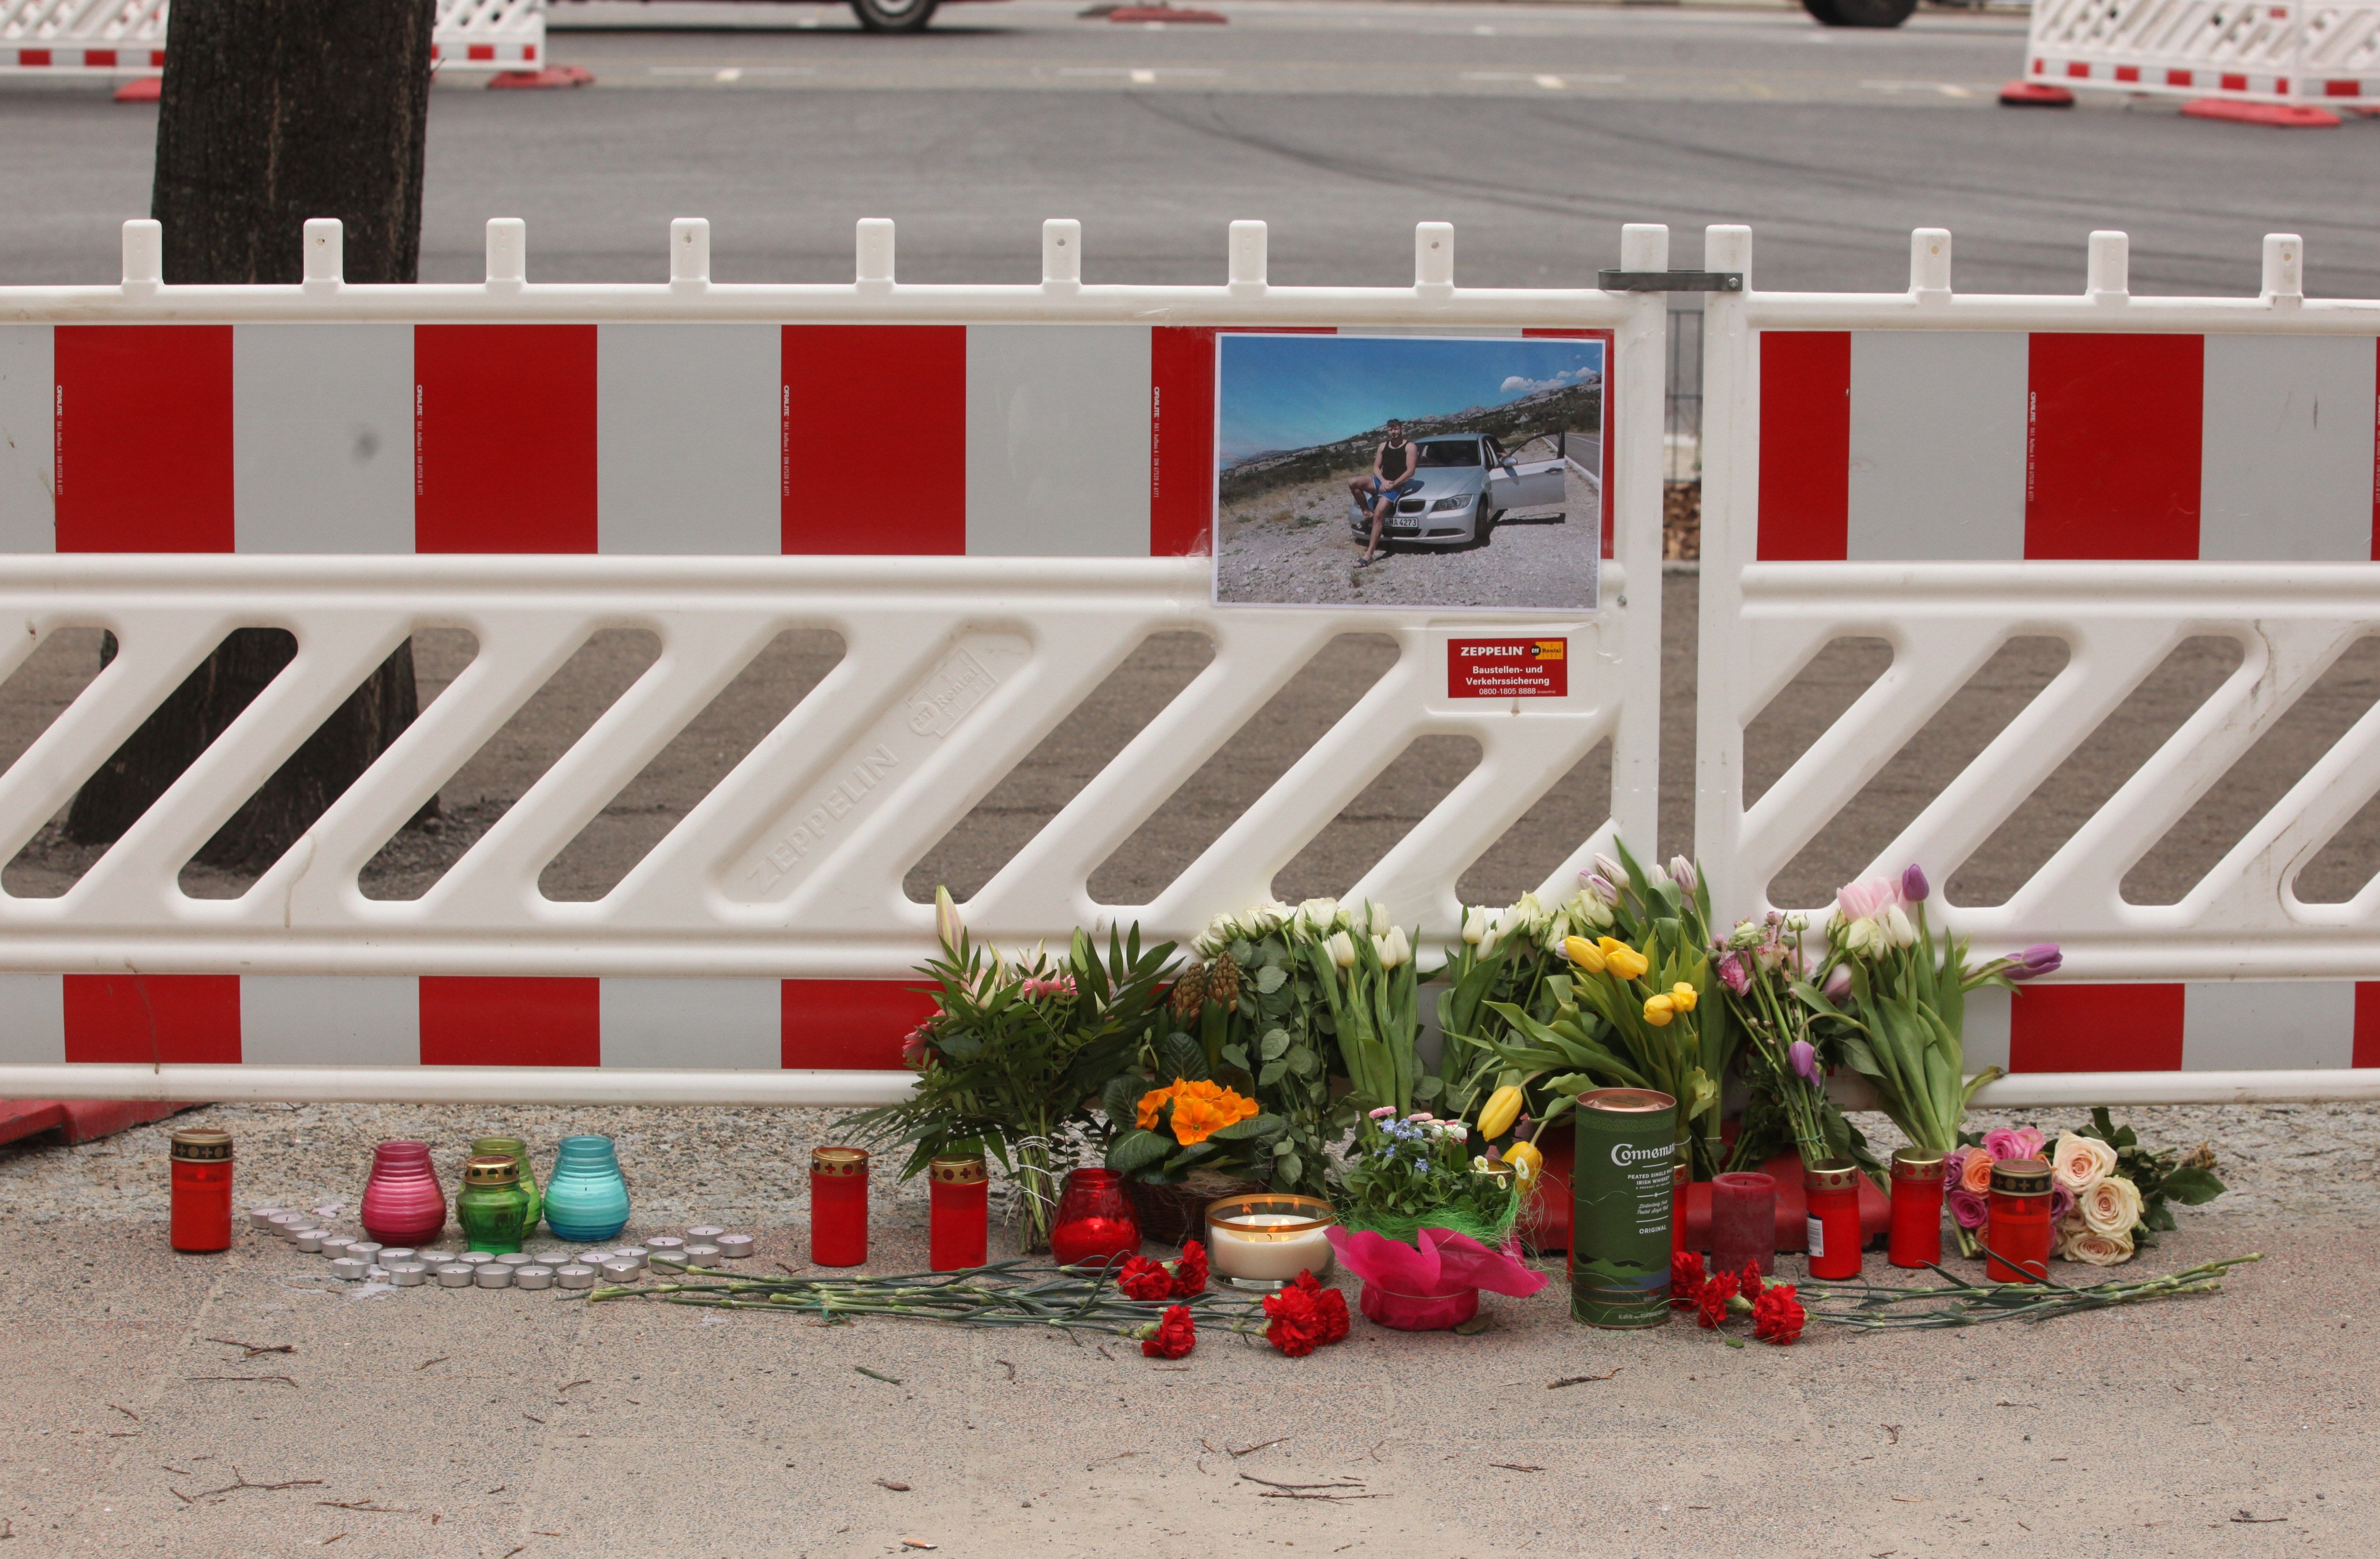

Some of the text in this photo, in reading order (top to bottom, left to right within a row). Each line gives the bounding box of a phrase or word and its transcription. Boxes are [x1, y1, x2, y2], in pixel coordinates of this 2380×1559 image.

[1461, 646, 1523, 656] ZEPPELIN
[1472, 665, 1543, 674] Baustellen- und
[1465, 677, 1550, 686] Verkehrssicherung
[934, 666, 979, 709] Rental
[747, 743, 899, 895] ZEPPELIN
[1652, 1175, 1670, 1183] WHISKEY
[1639, 1224, 1667, 1234] ORIGINAL
